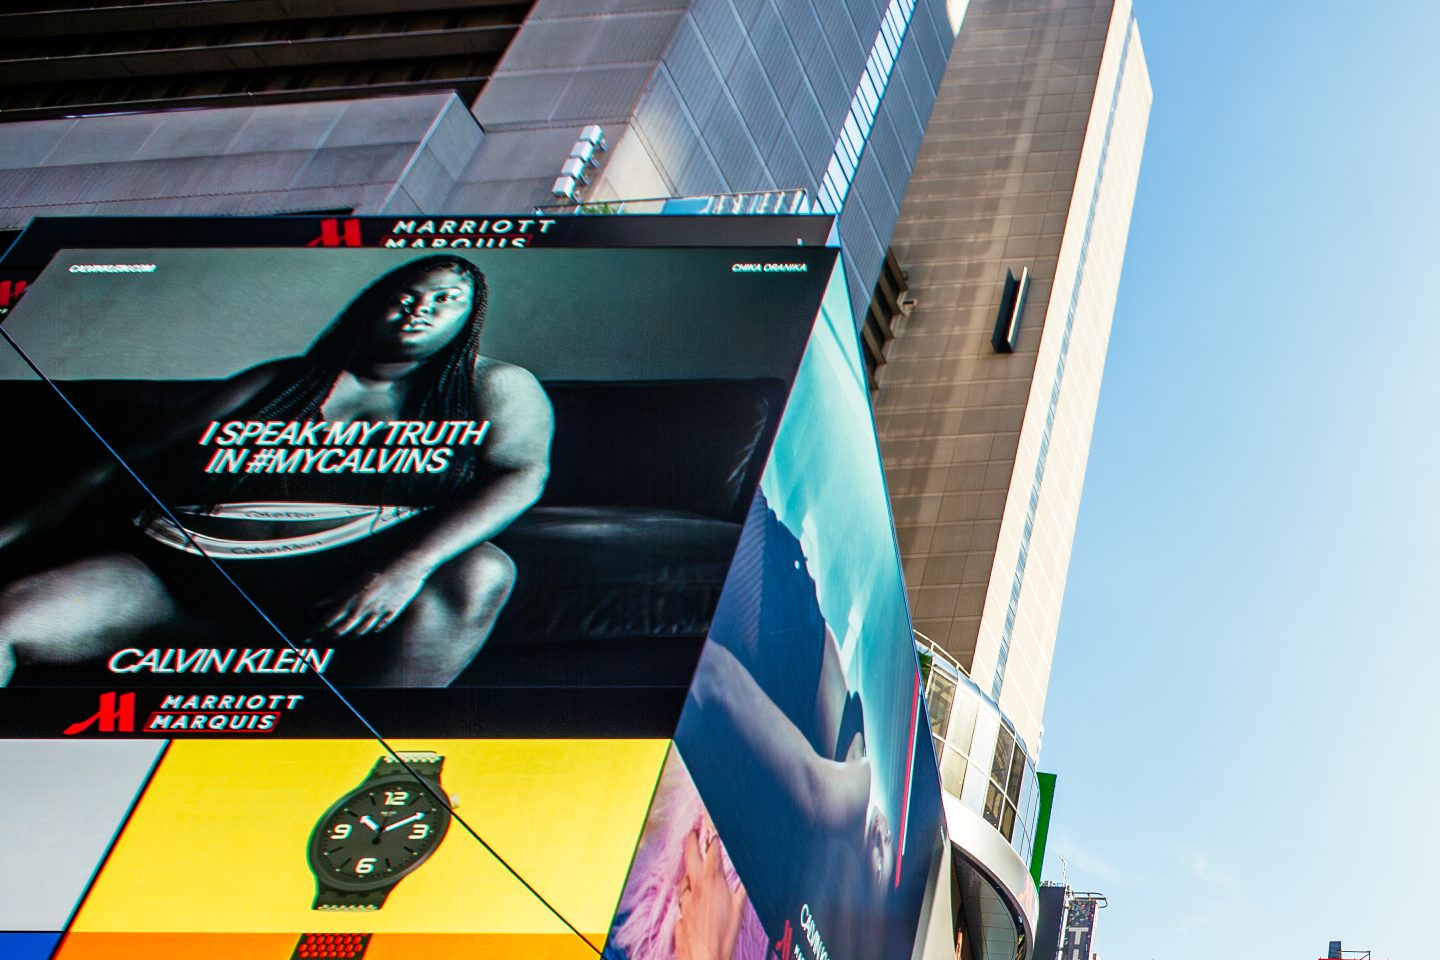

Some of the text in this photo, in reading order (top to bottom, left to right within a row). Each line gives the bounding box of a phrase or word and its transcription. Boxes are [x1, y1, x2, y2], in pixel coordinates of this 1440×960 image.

[392, 219, 556, 235] MARRIOTT
[198, 420, 491, 446] I SPEAK MY TRUTH
[204, 447, 455, 474] IN #MYCALVINS
[107, 647, 336, 674] CALVIN KLEIN
[160, 694, 304, 710] MARRIOTT
[149, 714, 277, 731] MARQUIS
[384, 791, 410, 806] 12
[330, 823, 431, 840] 9 3
[355, 857, 378, 874] 6
